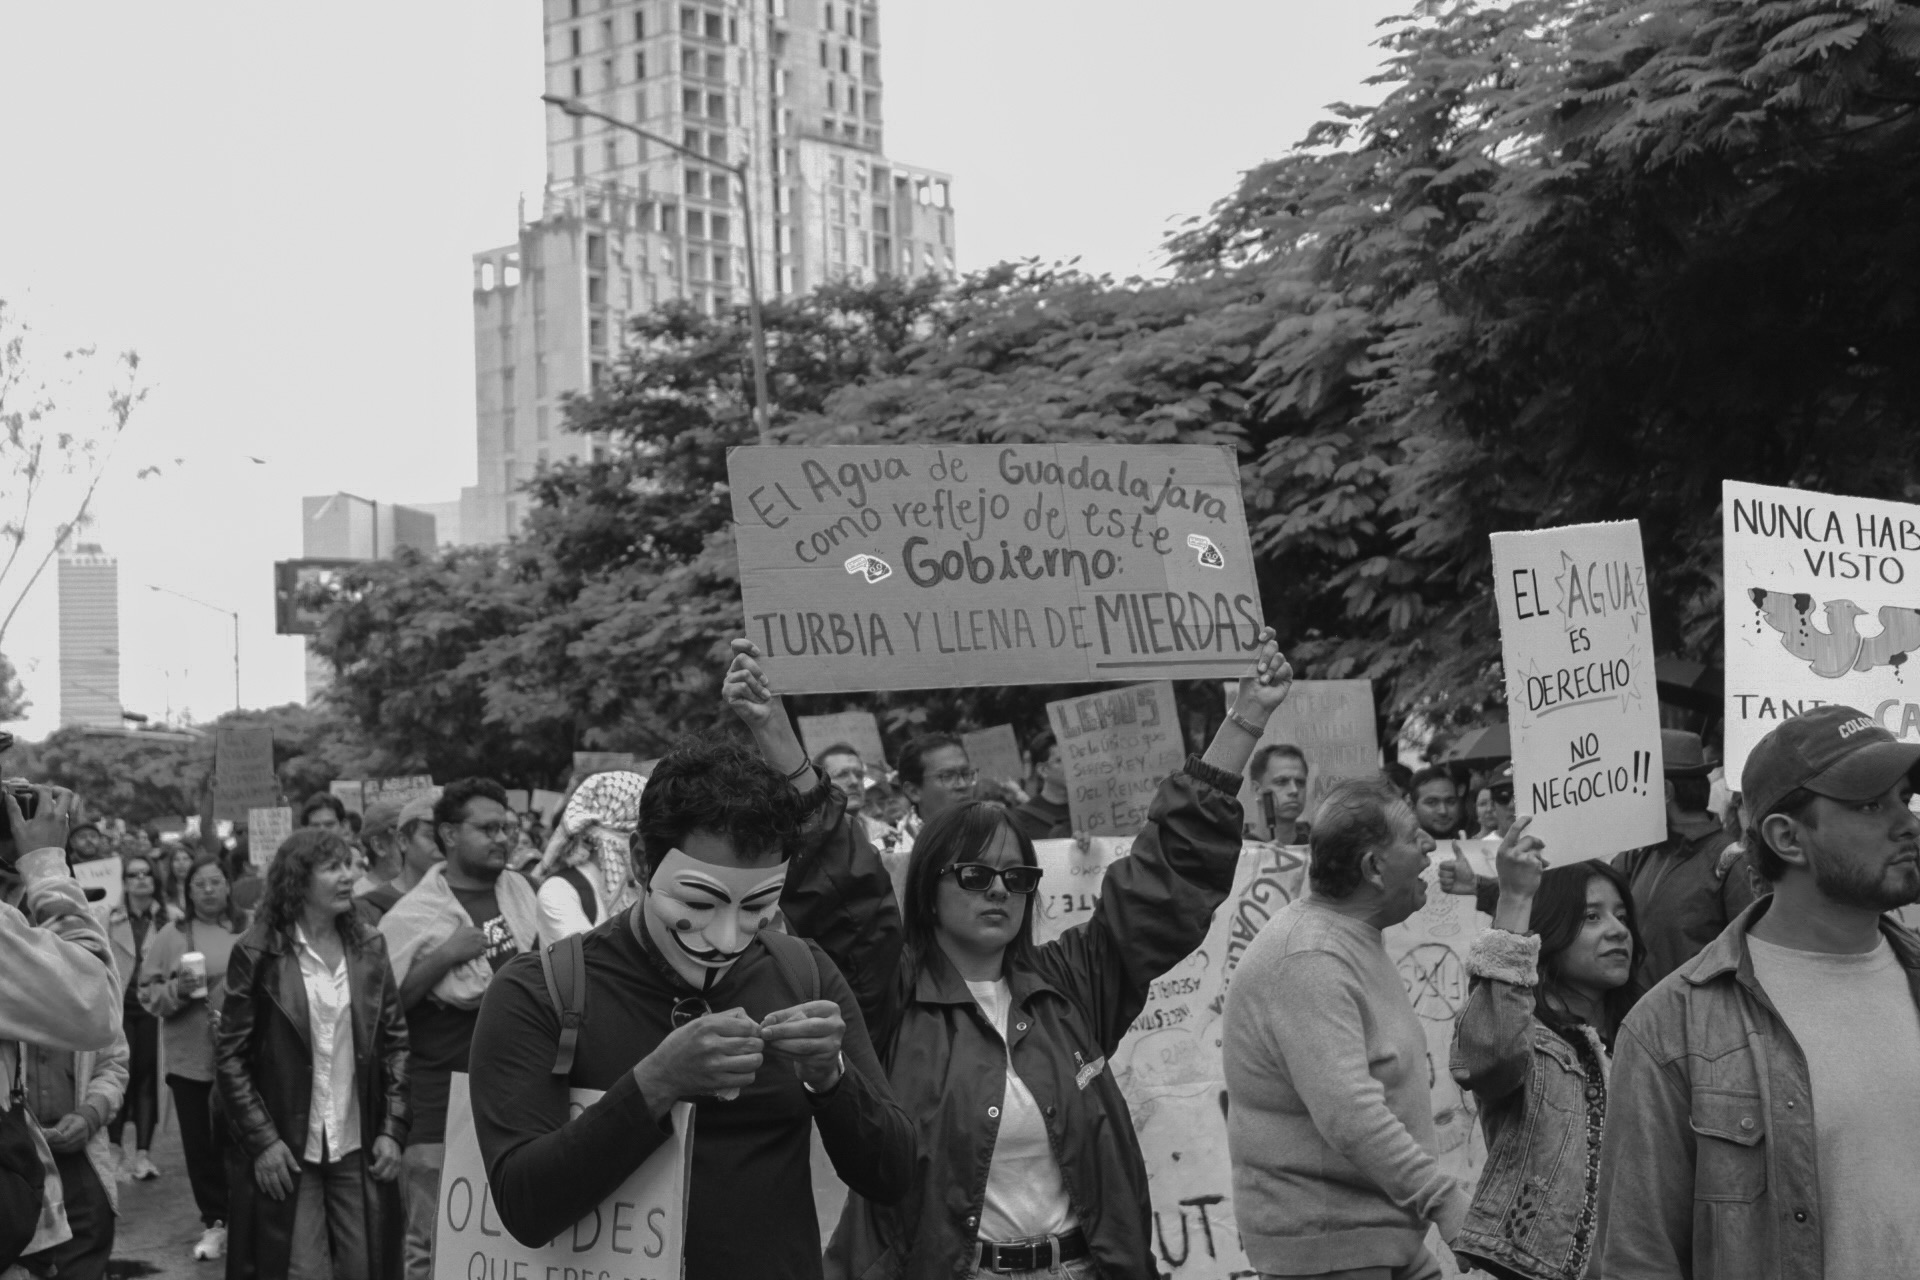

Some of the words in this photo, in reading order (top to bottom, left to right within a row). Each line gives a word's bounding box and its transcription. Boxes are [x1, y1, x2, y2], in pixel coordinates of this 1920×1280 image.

[748, 482, 802, 529] El
[801, 458, 912, 509] Agua
[929, 450, 968, 482] de
[999, 448, 1227, 523] Guadalajara
[795, 507, 882, 563] como
[892, 488, 1009, 541] reflejo
[1024, 492, 1066, 540] de
[1081, 503, 1173, 555] este
[1733, 498, 1844, 544] NUNCA
[902, 536, 1124, 588] Gobierno:
[1803, 547, 1904, 584] VISTO
[1512, 568, 1550, 620] EL
[1567, 561, 1637, 619] AGUA
[753, 611, 895, 657] TURBIA
[1044, 606, 1093, 649] DE
[1094, 591, 1261, 655] MIERDAS
[1570, 627, 1591, 653] ES
[1527, 658, 1630, 711] DERECHO
[1057, 688, 1161, 738] LEMUS
[1570, 732, 1599, 763] NO
[1532, 750, 1651, 815] NEGOCIO!!
